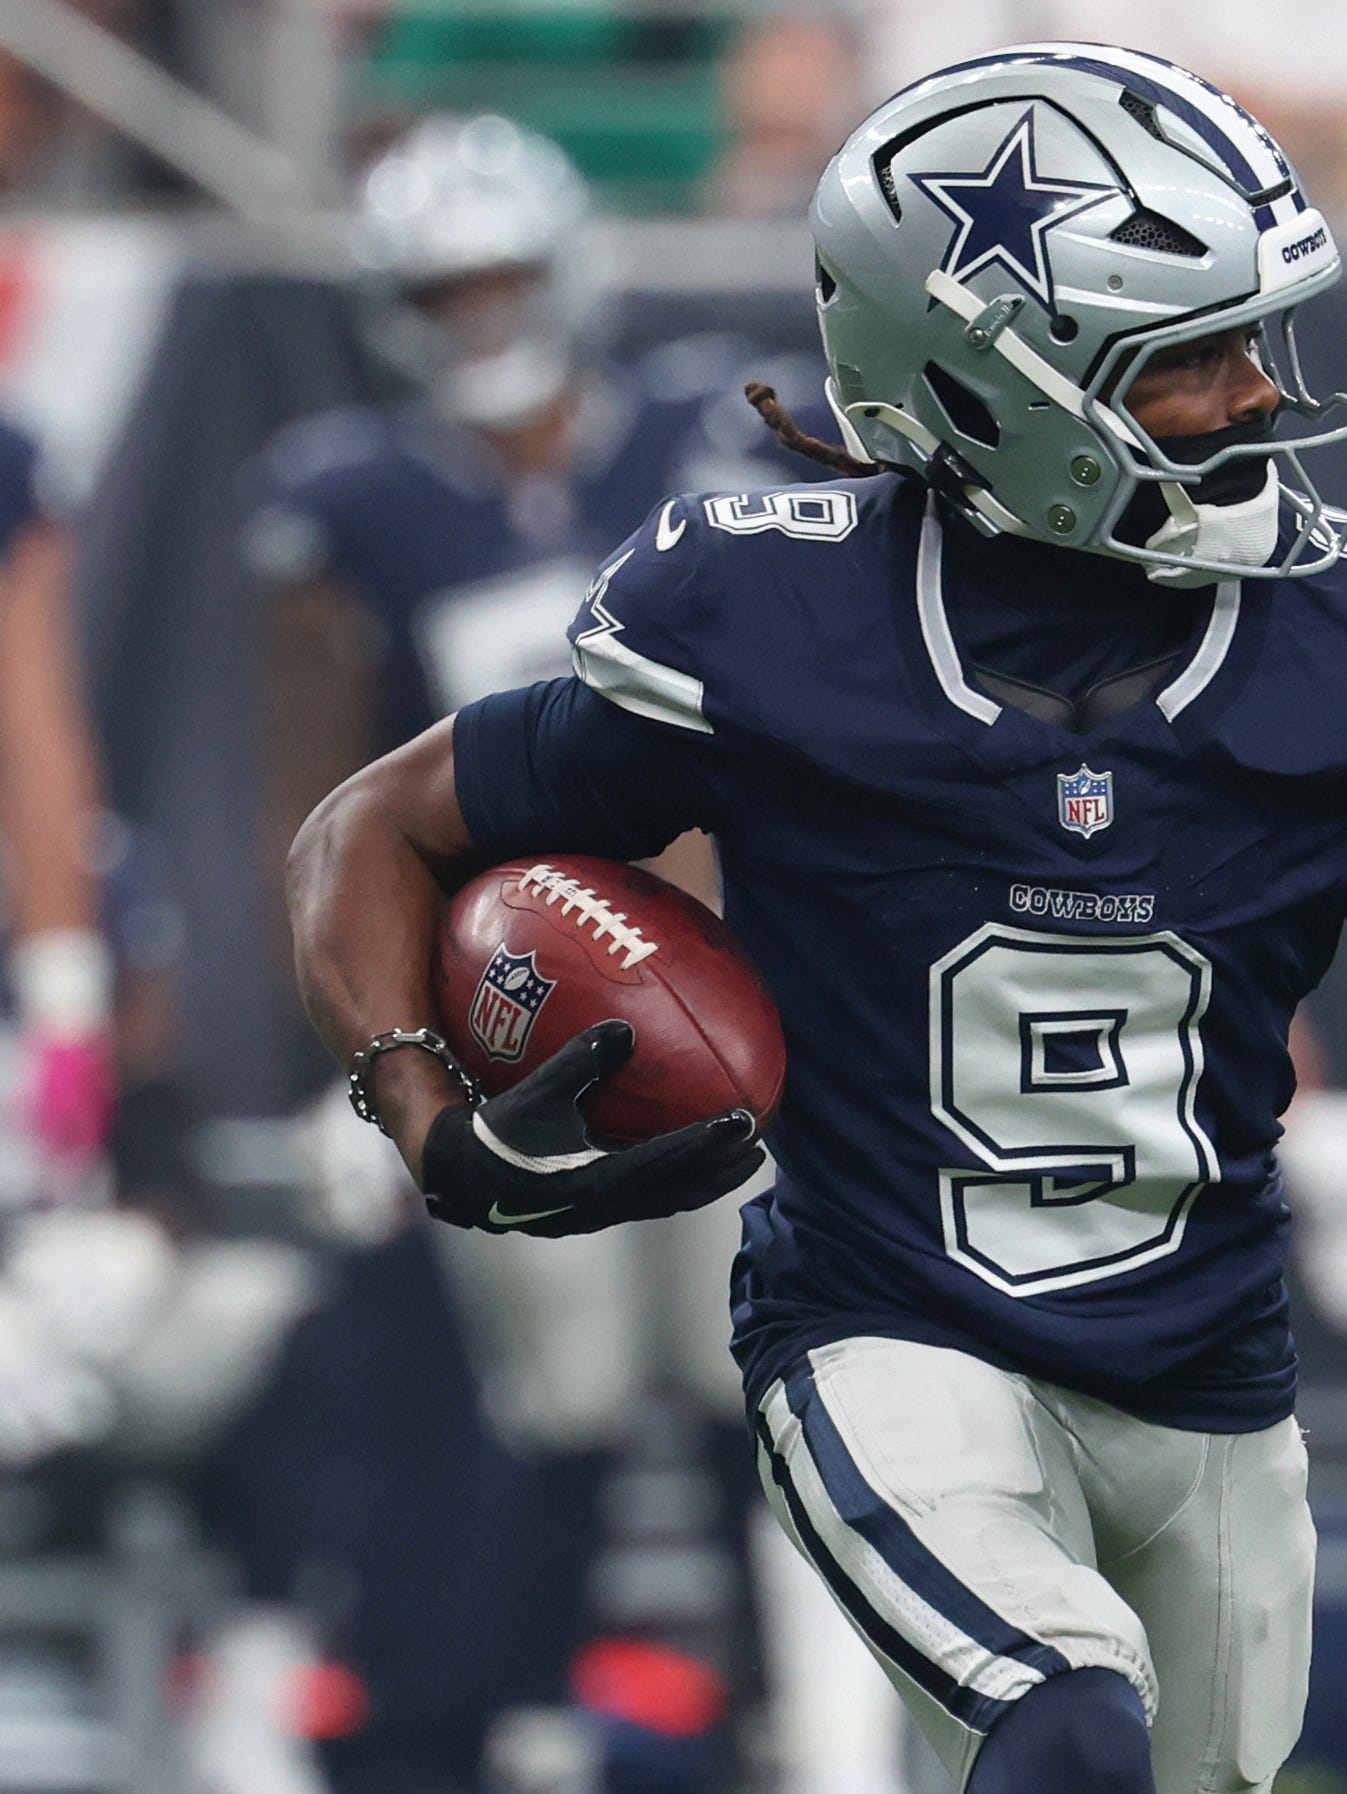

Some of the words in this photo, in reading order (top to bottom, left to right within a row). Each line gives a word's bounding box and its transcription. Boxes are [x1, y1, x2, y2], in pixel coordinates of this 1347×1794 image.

[703, 490, 858, 542] 9
[1067, 798, 1106, 826] NFL
[1009, 883, 1155, 923] COWBOYS
[474, 986, 522, 1053] NFL
[928, 921, 1222, 1298] 9
